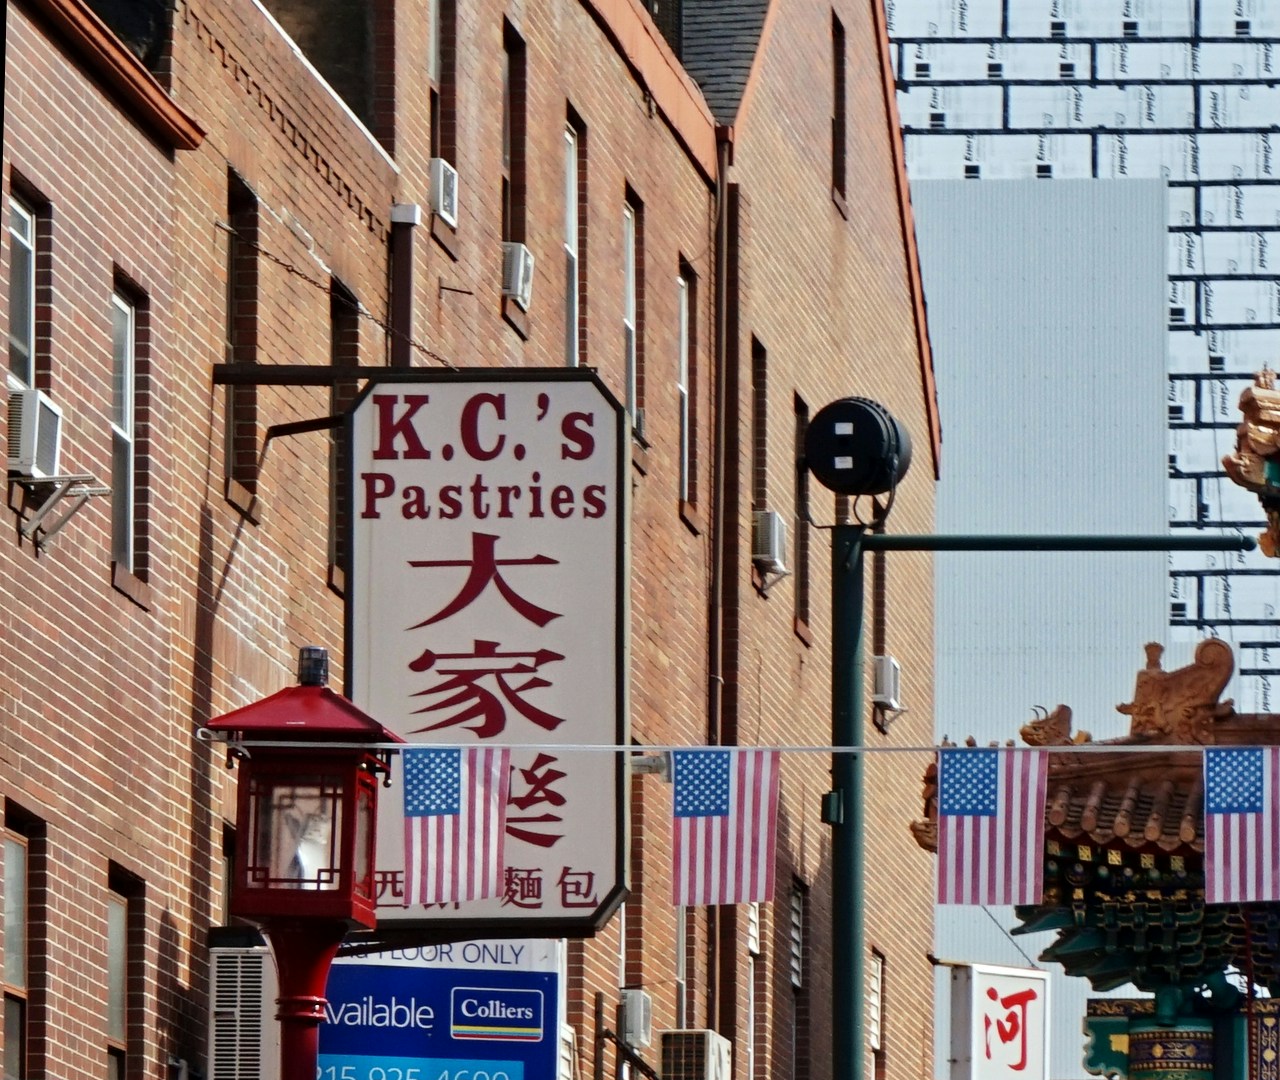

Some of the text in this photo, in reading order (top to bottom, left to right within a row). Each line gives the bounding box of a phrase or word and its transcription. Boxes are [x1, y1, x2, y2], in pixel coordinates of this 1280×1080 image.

[372, 392, 597, 462] K.C.'s
[360, 472, 607, 520] Pastries
[462, 943, 525, 965] ONLY
[461, 999, 534, 1019] Colliers
